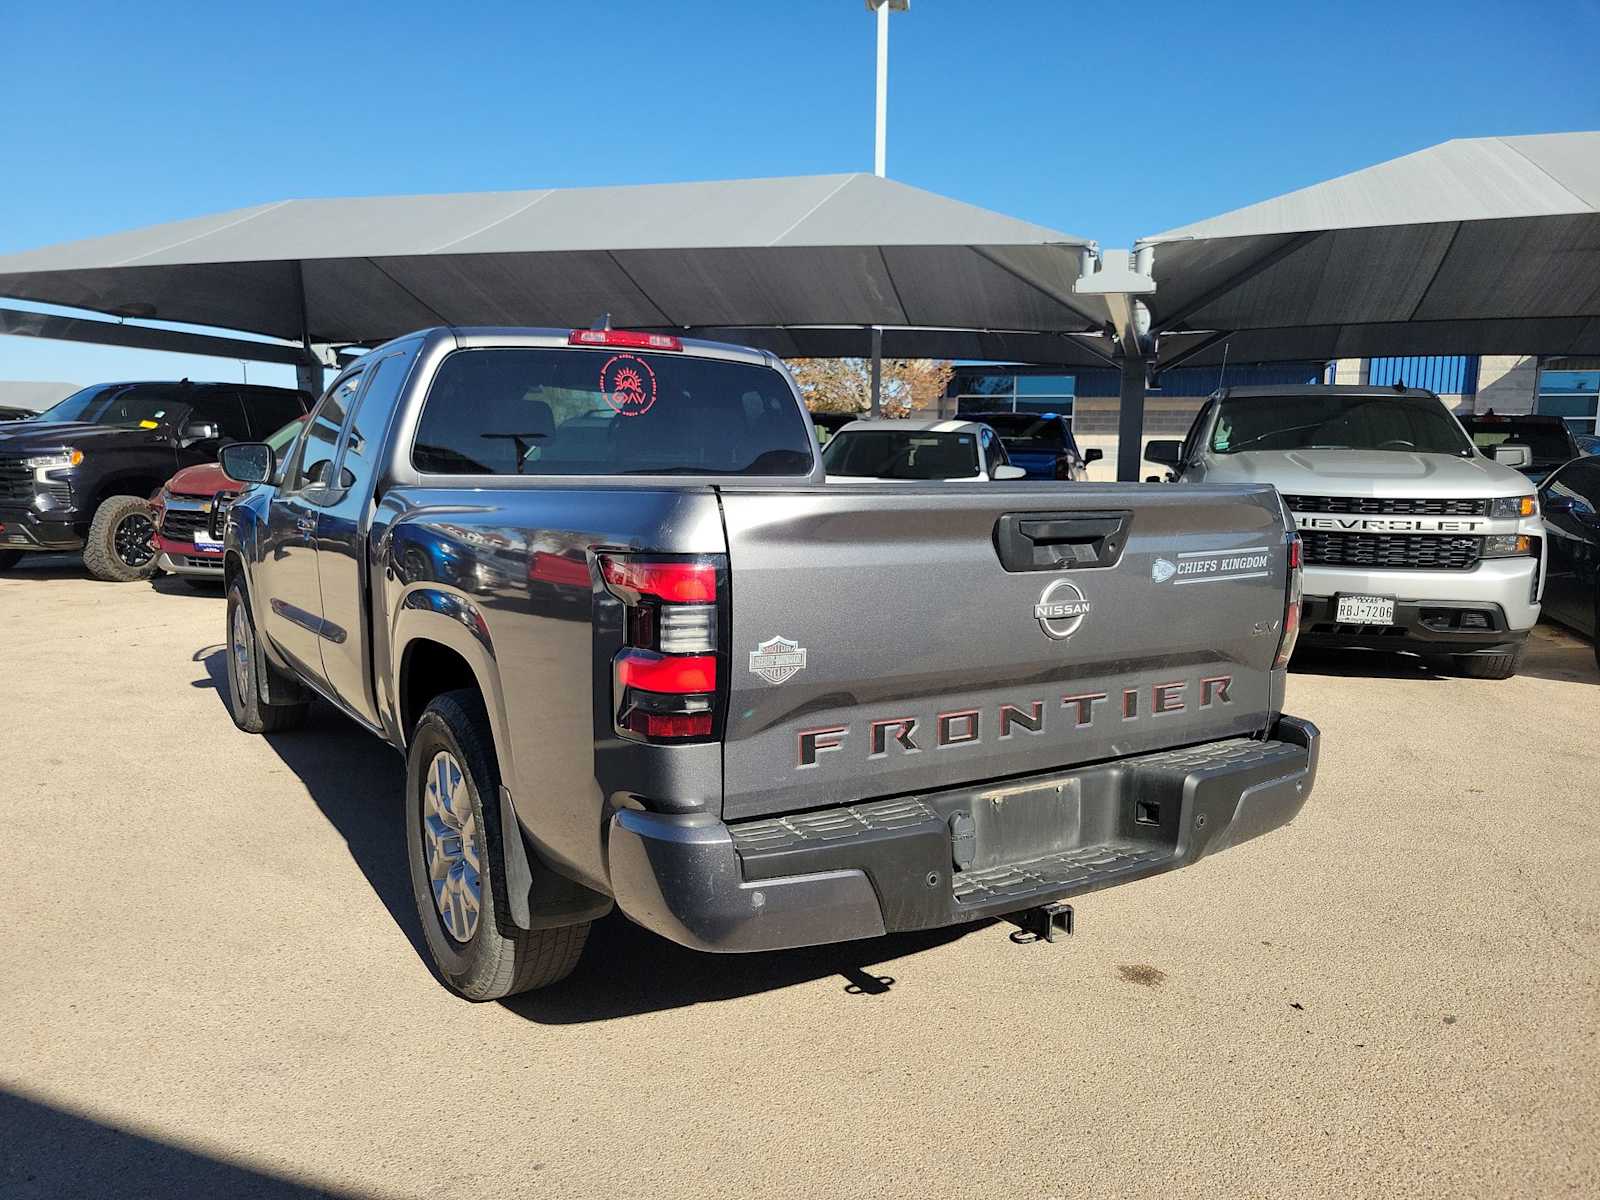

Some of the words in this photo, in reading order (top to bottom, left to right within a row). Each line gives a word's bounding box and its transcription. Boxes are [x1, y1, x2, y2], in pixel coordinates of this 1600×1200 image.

[1296, 517, 1484, 532] HEVROLET
[1177, 560, 1218, 575] CHIEFS
[1220, 555, 1268, 571] KINGDOM
[1036, 602, 1090, 616] NISSAN
[1252, 619, 1279, 635] SV
[795, 674, 1233, 769] FRONTIER
